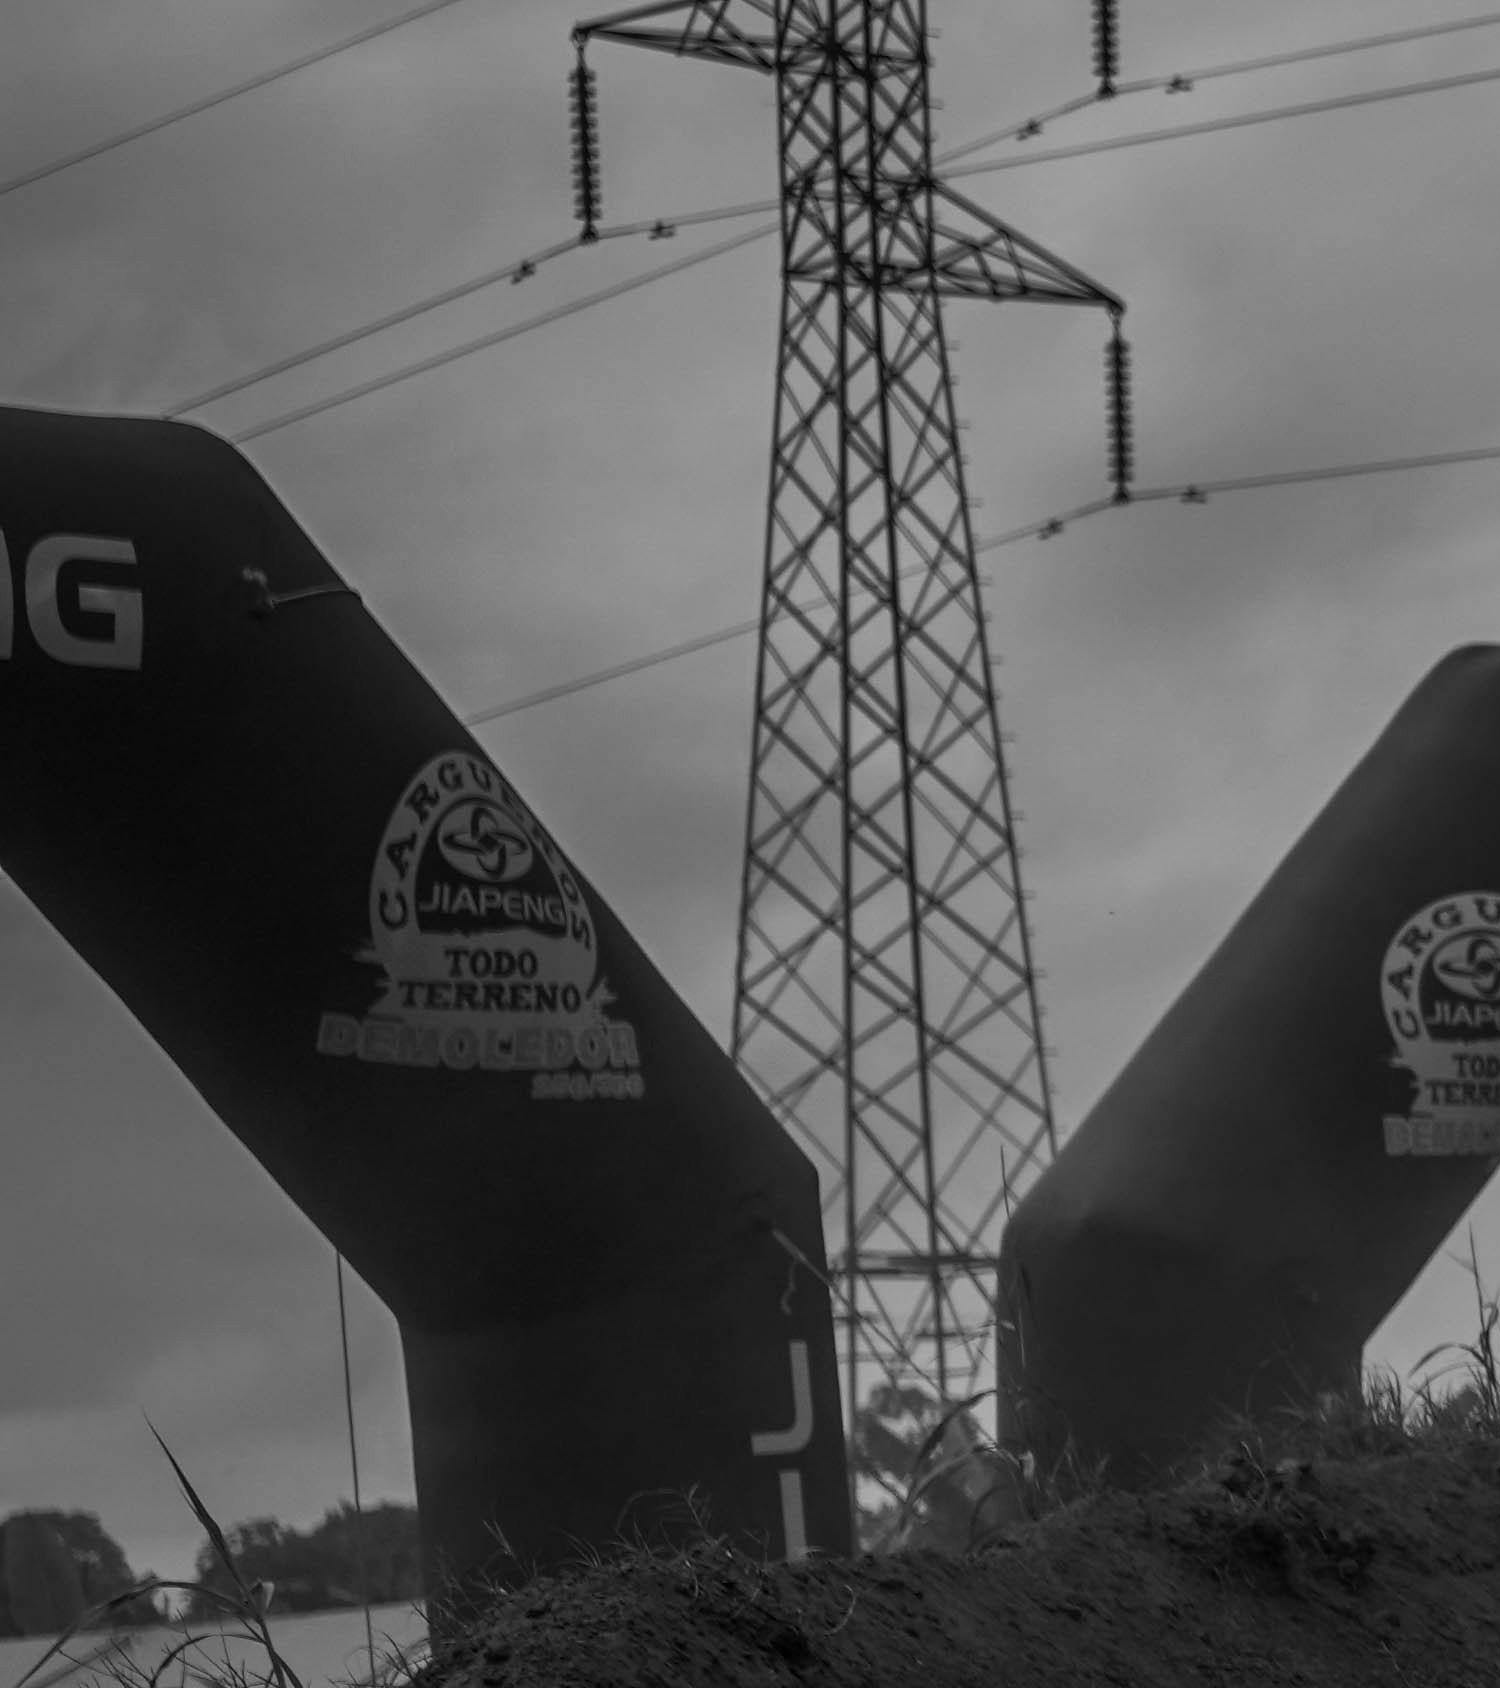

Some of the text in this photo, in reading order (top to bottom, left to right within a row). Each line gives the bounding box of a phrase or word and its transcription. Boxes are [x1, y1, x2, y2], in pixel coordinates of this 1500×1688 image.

[419, 881, 568, 926] JIAPENG
[445, 949, 539, 979] TODO
[399, 981, 582, 1014] TERRENO
